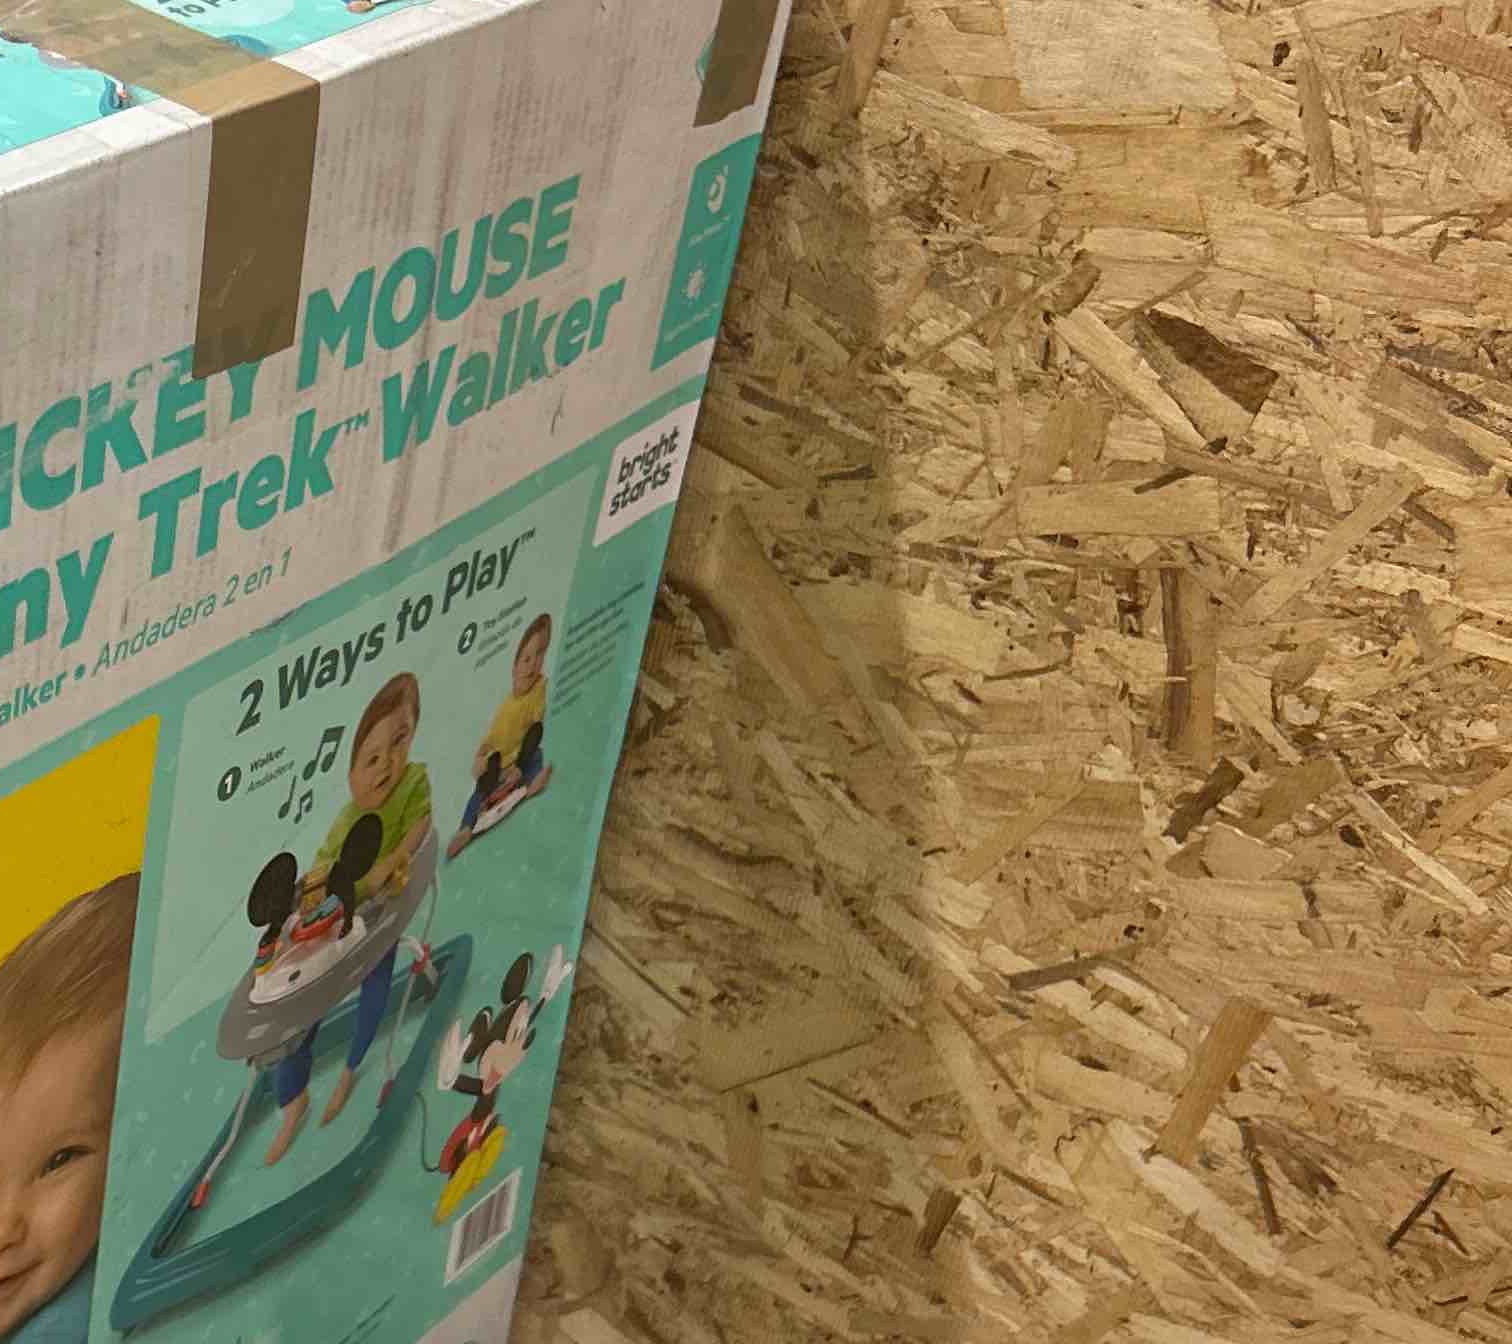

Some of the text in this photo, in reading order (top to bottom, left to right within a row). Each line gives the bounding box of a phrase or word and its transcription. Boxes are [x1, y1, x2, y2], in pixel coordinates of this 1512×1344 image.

[167, 3, 206, 17] to
[296, 174, 582, 394] MOUSE
[381, 277, 627, 463] Walker
[608, 462, 672, 517] starts
[617, 425, 680, 484] bright
[92, 591, 216, 677] Andadera
[222, 577, 241, 607] 2
[243, 565, 274, 595] en
[281, 545, 294, 577] 1
[235, 678, 265, 737] 2
[277, 620, 387, 711] Ways
[396, 594, 434, 644] to
